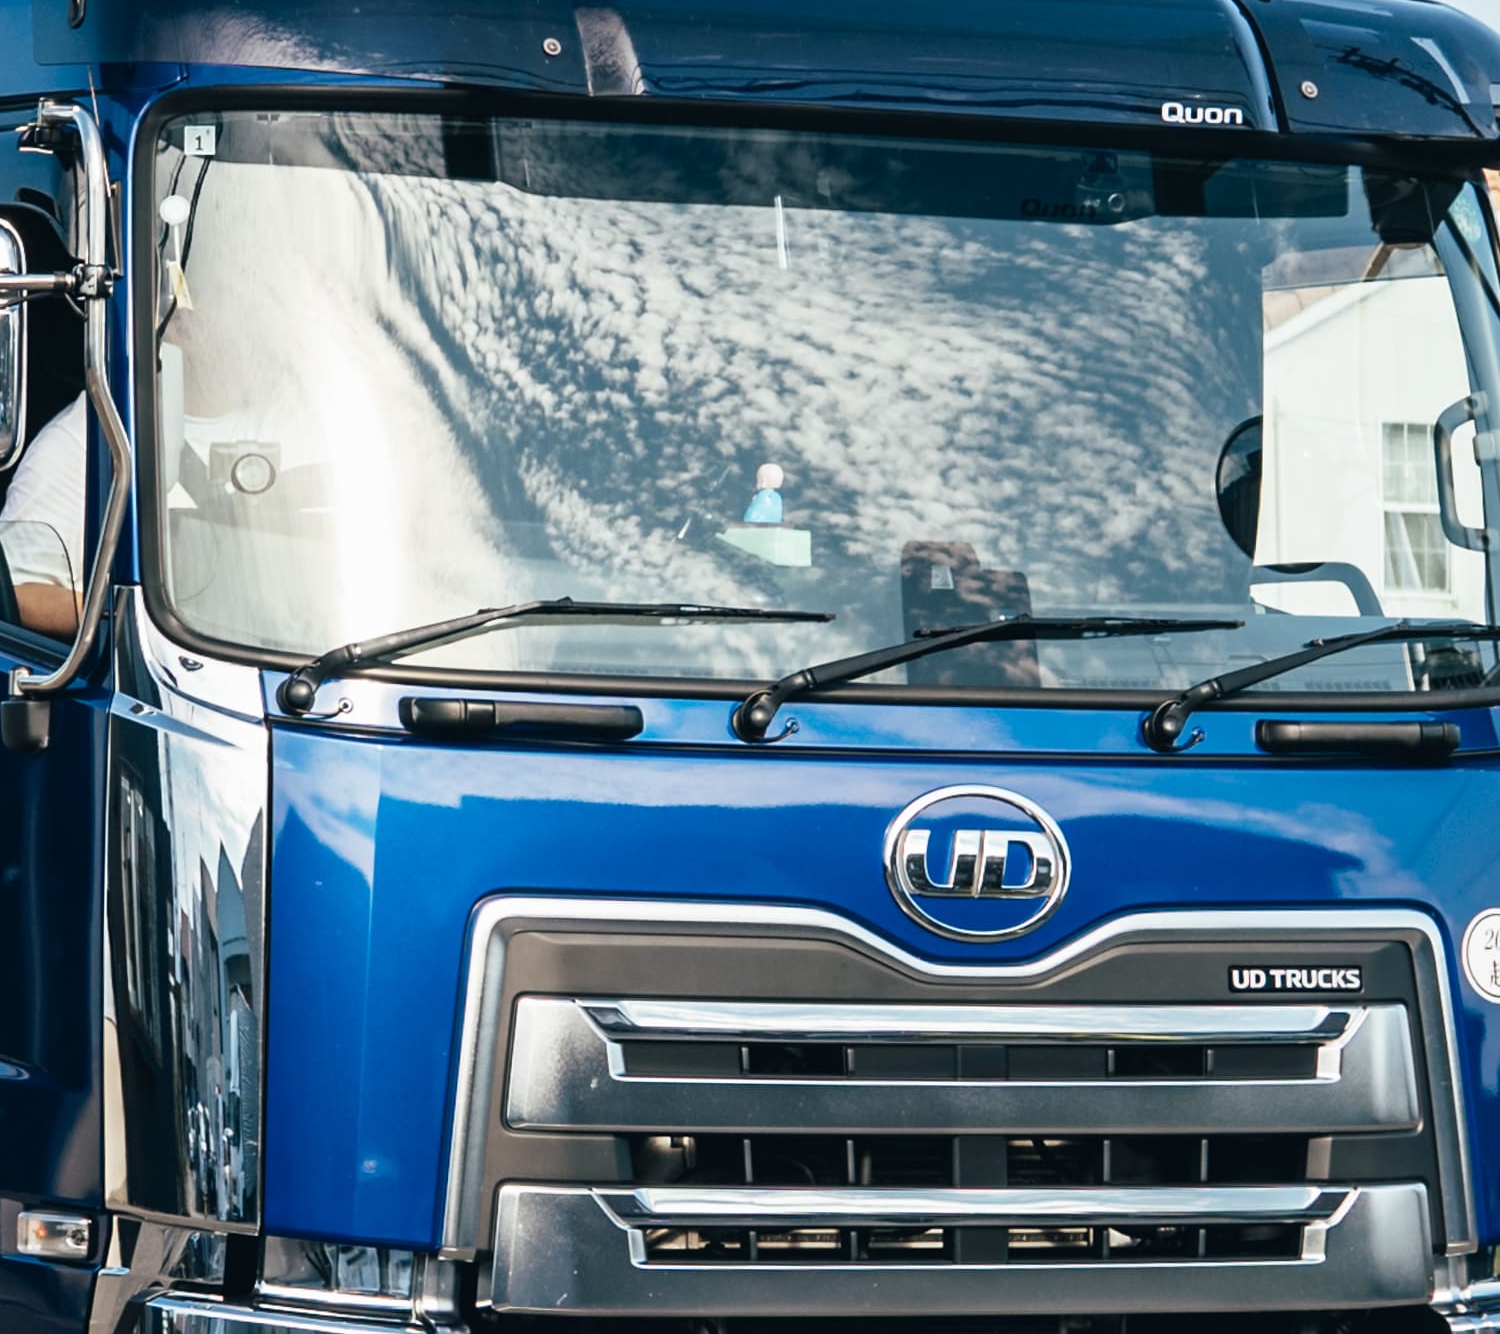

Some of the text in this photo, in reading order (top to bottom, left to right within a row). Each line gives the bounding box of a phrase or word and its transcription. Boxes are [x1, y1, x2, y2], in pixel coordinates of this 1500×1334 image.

[1161, 101, 1243, 126] Quon
[894, 827, 1060, 899] UD
[1231, 968, 1361, 989] UD TRUCKS
